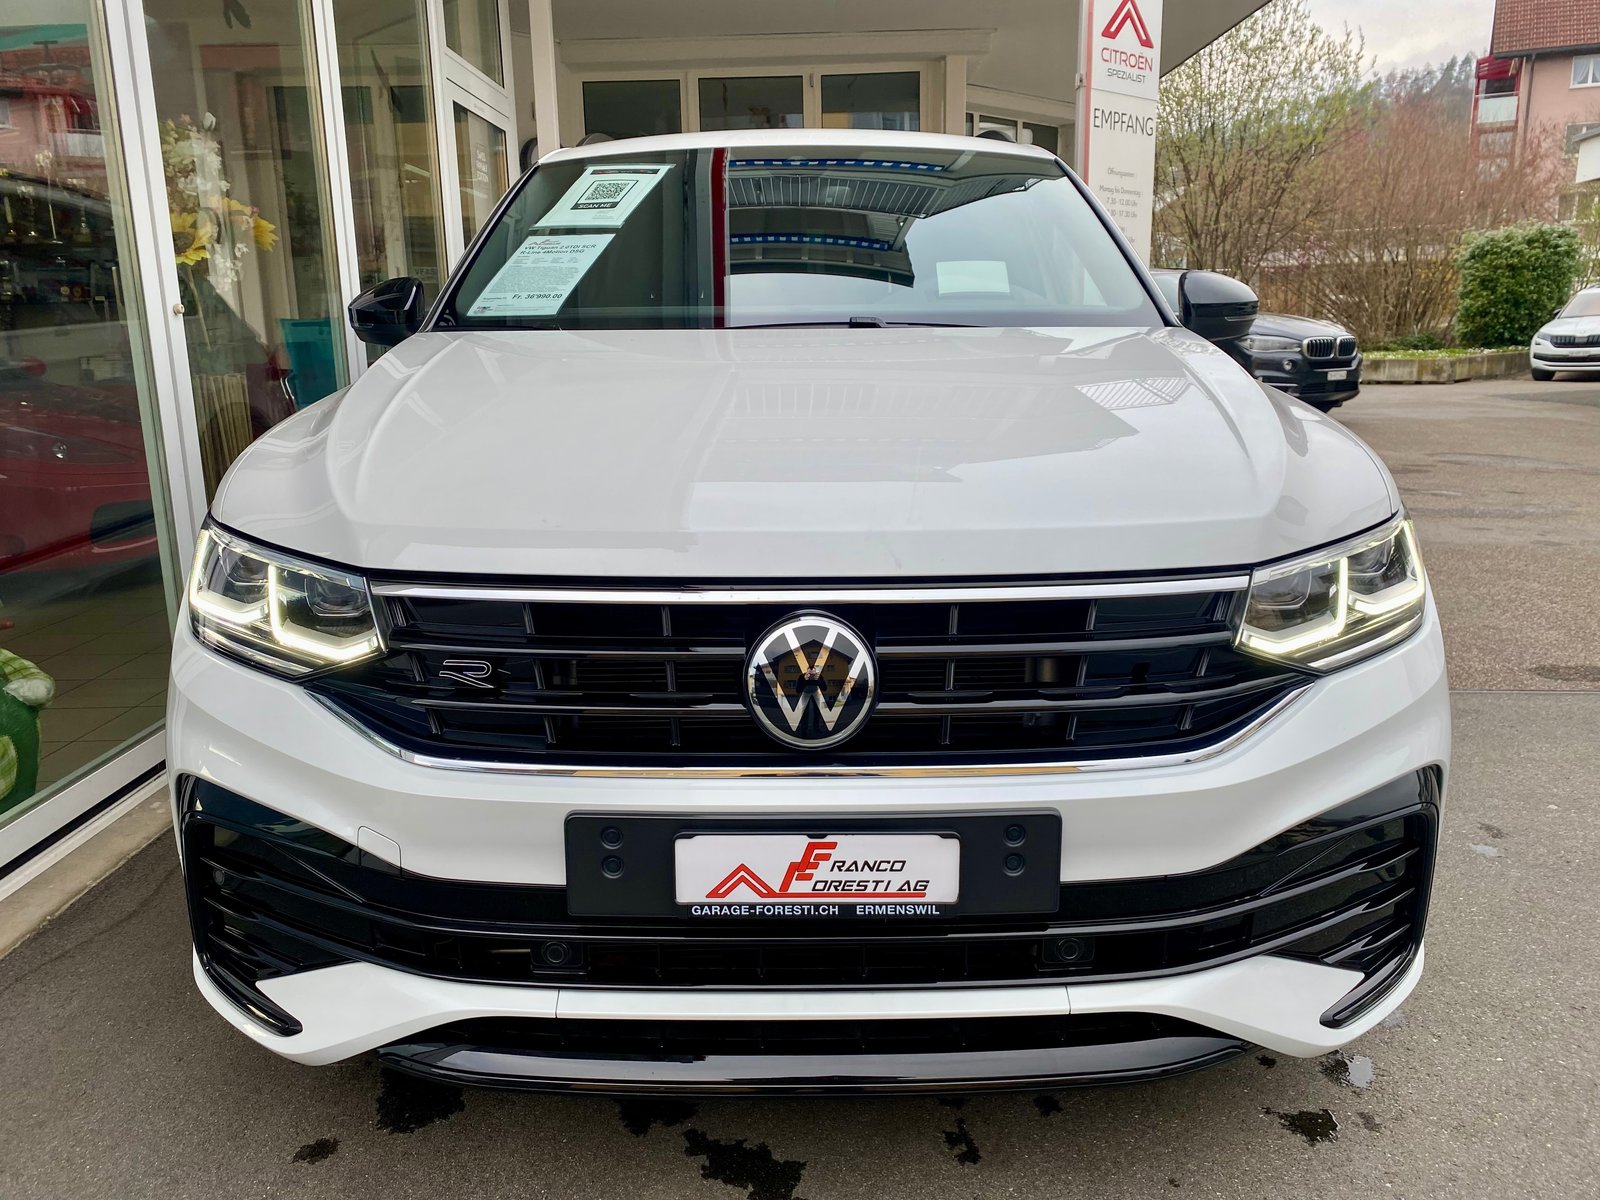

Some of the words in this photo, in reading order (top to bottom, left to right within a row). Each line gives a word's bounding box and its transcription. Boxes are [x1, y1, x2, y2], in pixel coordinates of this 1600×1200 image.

[1101, 47, 1153, 72] CITROËN
[1107, 68, 1146, 83] SPEZIALIST
[1093, 107, 1154, 136] EMPFANG
[896, 880, 930, 892] AG
[691, 904, 839, 916] GARAGE-FORESTI.CH
[856, 904, 940, 915] ERMENSWIL
